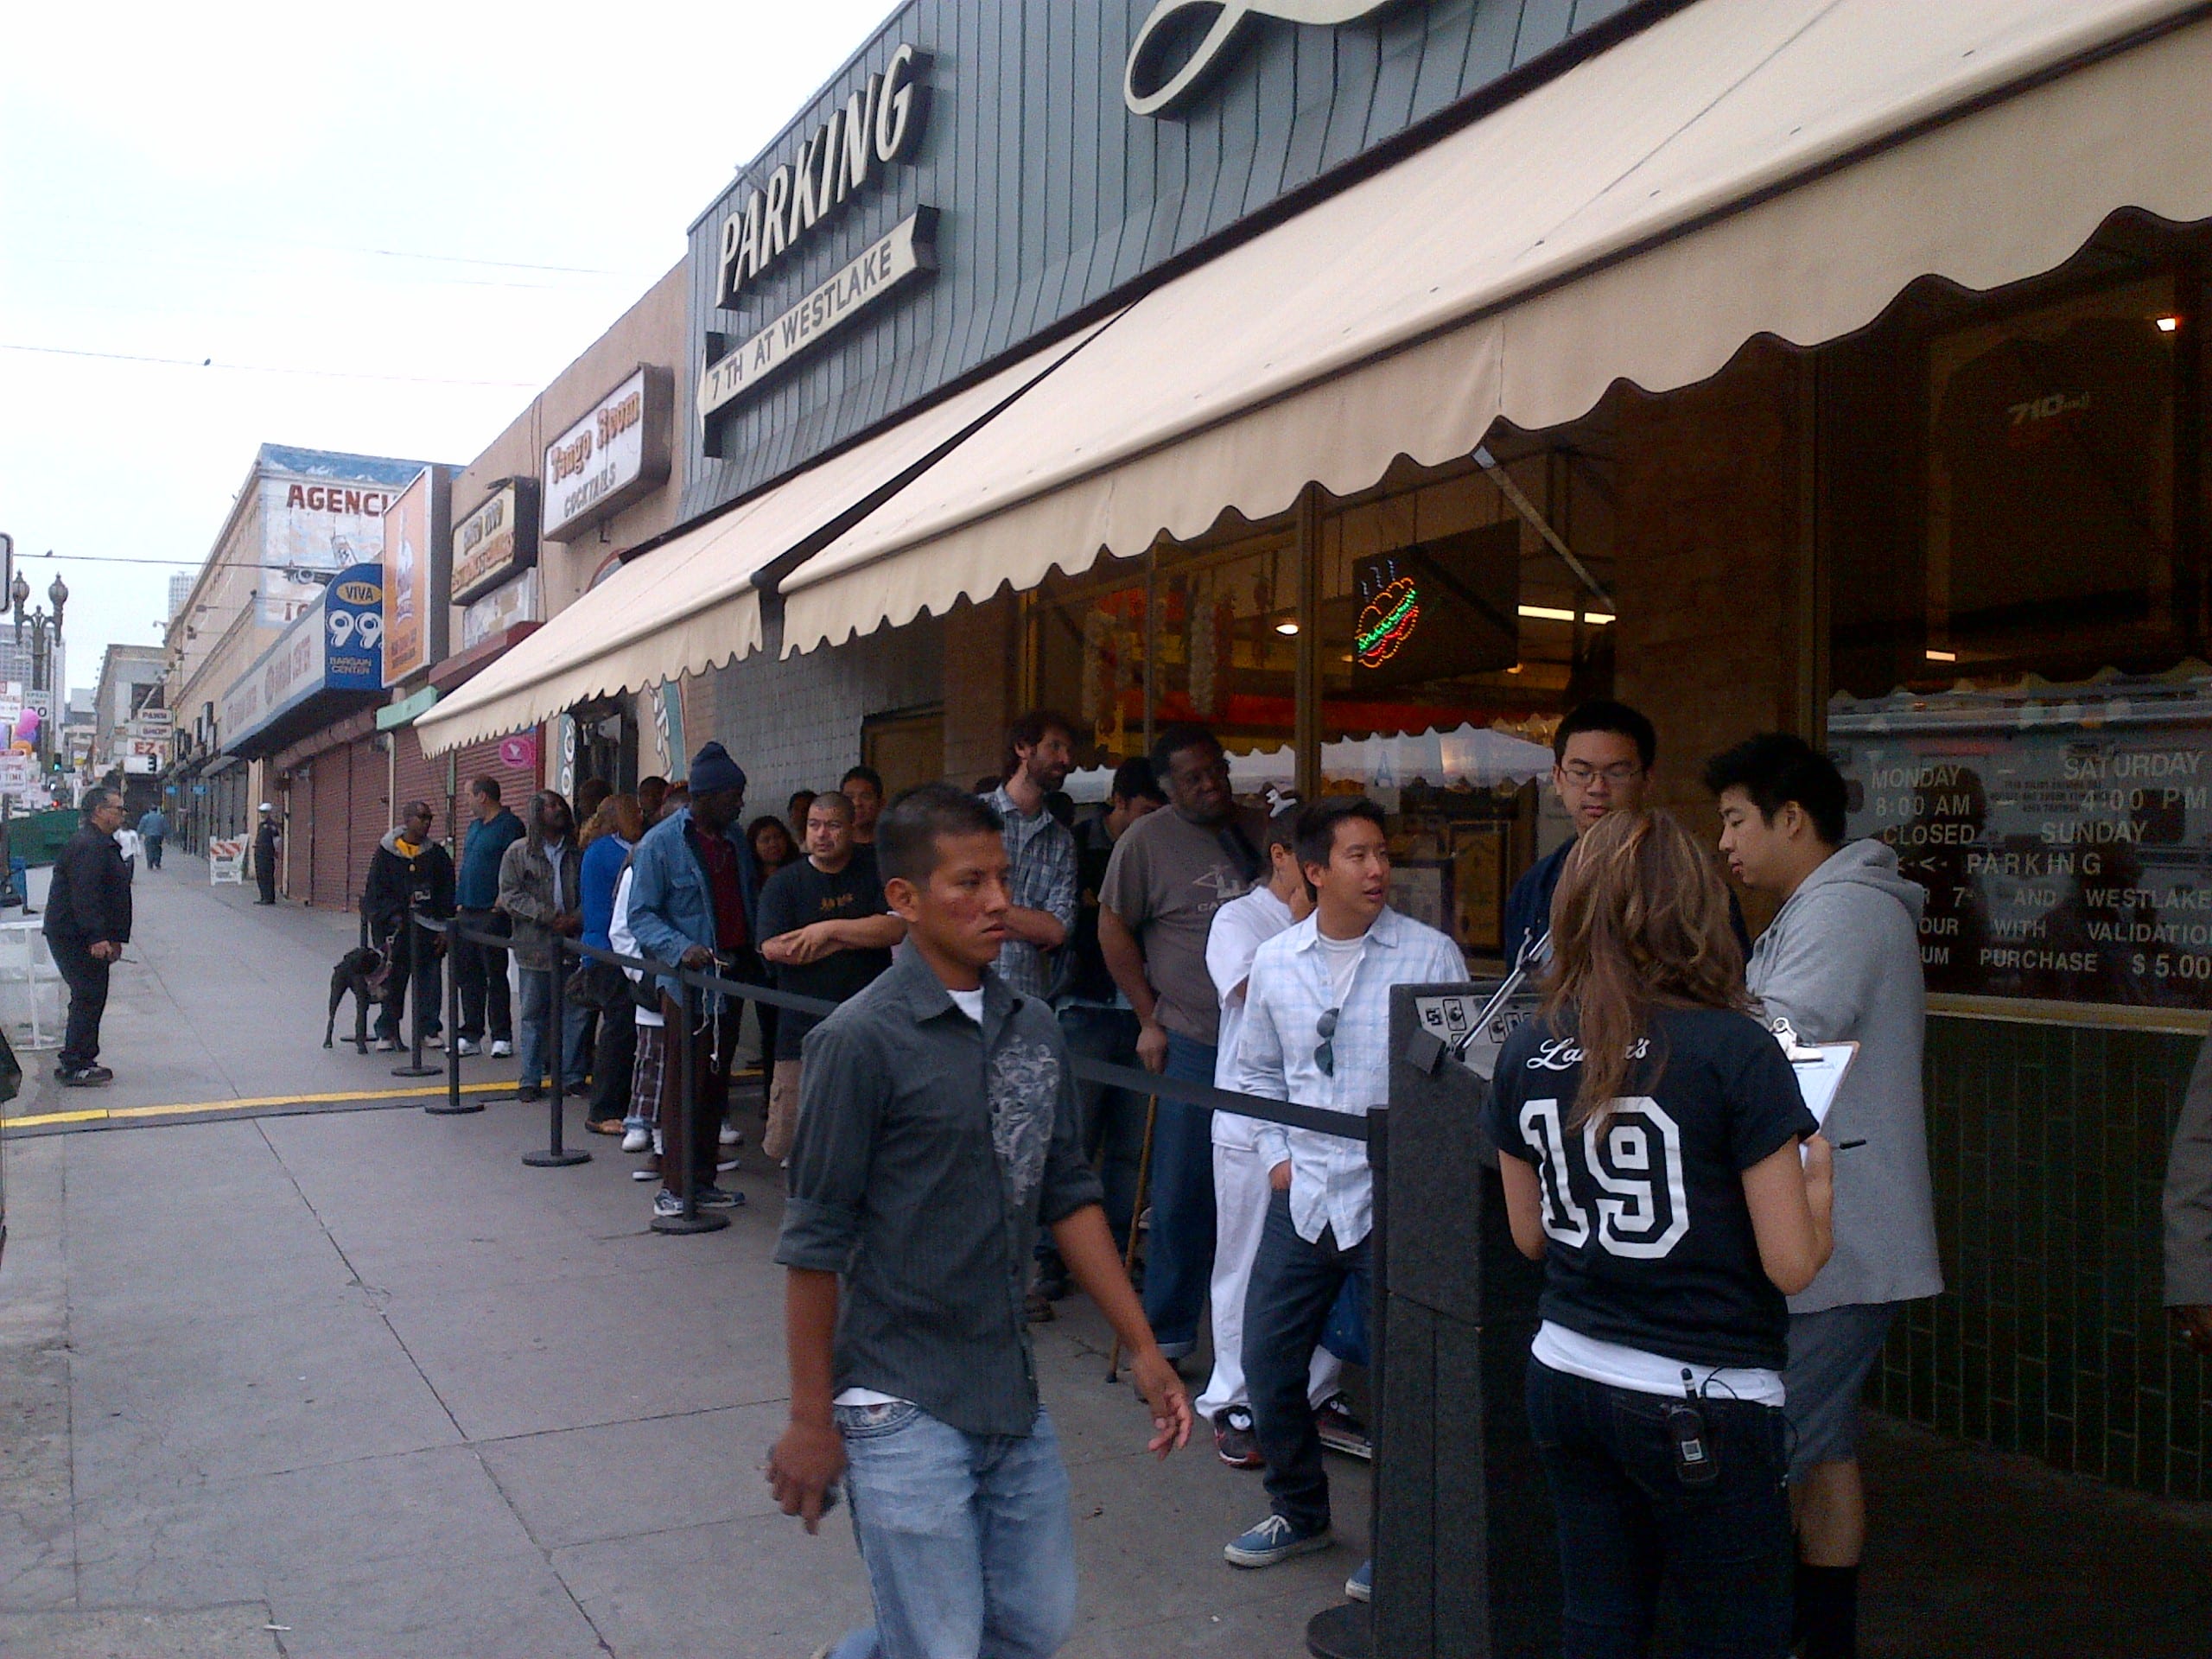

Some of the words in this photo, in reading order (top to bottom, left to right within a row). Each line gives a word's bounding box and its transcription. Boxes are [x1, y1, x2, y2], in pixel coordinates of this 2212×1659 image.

[716, 43, 913, 308] PARKING
[712, 370, 721, 400] 7
[725, 353, 743, 389] TH
[753, 330, 775, 372] AT
[782, 239, 893, 348] WESTLAKE
[286, 484, 397, 517] AGENCI
[563, 461, 617, 518] COCKTAILS
[346, 586, 374, 601] VIVA
[1872, 765, 1961, 789] MONDAY
[2063, 751, 2202, 780] SATURDAY
[1935, 793, 1971, 816] AM
[2162, 786, 2209, 810] PM
[1884, 823, 1976, 845] CLOSED
[2040, 821, 2147, 845] SUNDAY
[1966, 852, 2101, 875] PARKING
[2014, 888, 2057, 907] AND
[2085, 888, 2212, 909] WESTLAKE
[1919, 918, 1959, 936] OUR
[1993, 918, 2047, 939] WITH
[1980, 948, 2099, 973] PURCHASE
[1519, 1095, 1690, 1259] 19
